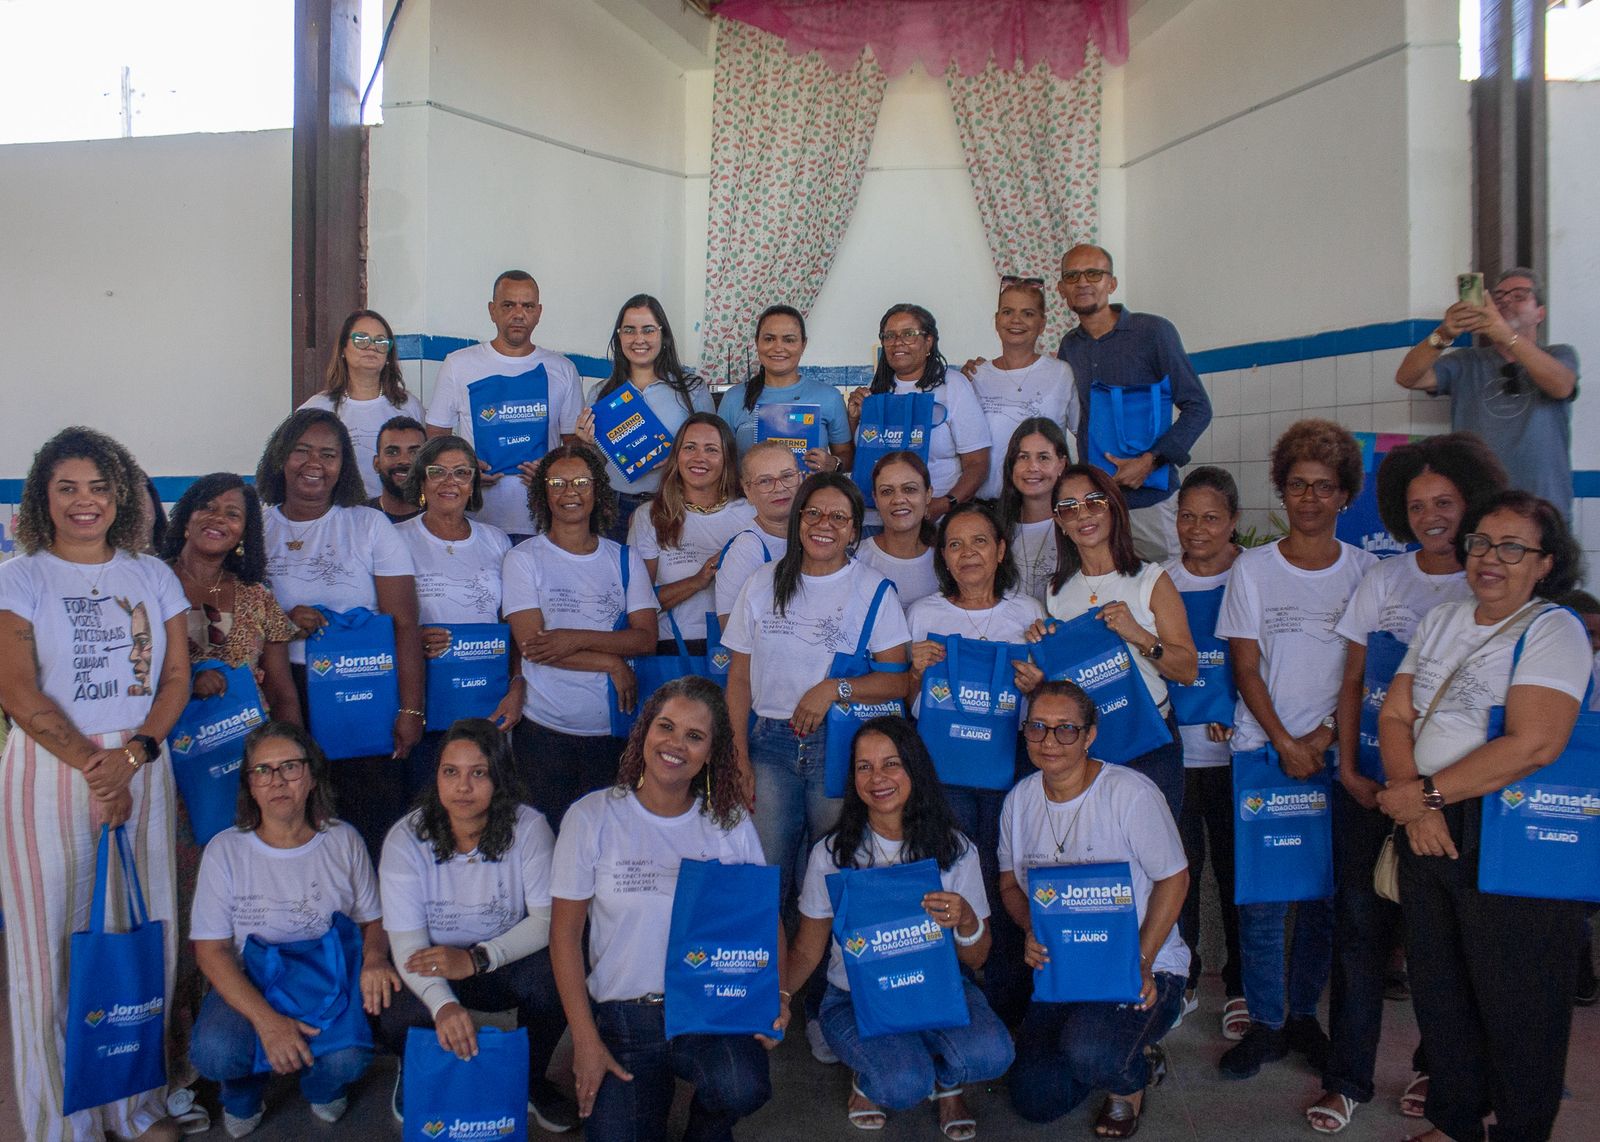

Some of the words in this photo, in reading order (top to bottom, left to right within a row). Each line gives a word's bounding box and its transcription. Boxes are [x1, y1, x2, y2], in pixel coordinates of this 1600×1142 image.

[498, 402, 547, 415] Jornada
[608, 414, 641, 439] CADERNO
[507, 436, 531, 445] LAURO
[64, 600, 103, 616] FORAM
[73, 626, 126, 642] ANCESTRAIS
[453, 638, 506, 651] Jornada
[73, 656, 110, 669] GUIARAM
[335, 653, 393, 668] Jornada
[1076, 651, 1130, 683] Jornada
[461, 679, 487, 688] LAURO
[345, 692, 373, 702] LAURO
[959, 686, 1017, 704] Jornda
[1101, 698, 1128, 715] LAURO
[195, 707, 261, 740] Jornada
[961, 730, 991, 740] LAURO
[1266, 790, 1327, 806] Jornada
[1529, 789, 1600, 808] Jornada
[1273, 838, 1302, 846] LAURO
[1538, 831, 1578, 843] LAURO
[1060, 884, 1132, 899] Jornada
[1061, 897, 1113, 907] PEDAGÓGICA
[871, 919, 941, 945] Jornada
[1073, 933, 1109, 942] LAURO
[872, 936, 925, 953] PEDAGÓGICA
[711, 947, 770, 961] Jornada
[890, 974, 925, 989] LAURO
[716, 987, 747, 998] LAURO
[108, 997, 164, 1017] Jornada
[107, 1043, 140, 1056] LAURO
[448, 1116, 516, 1132] Jornada
